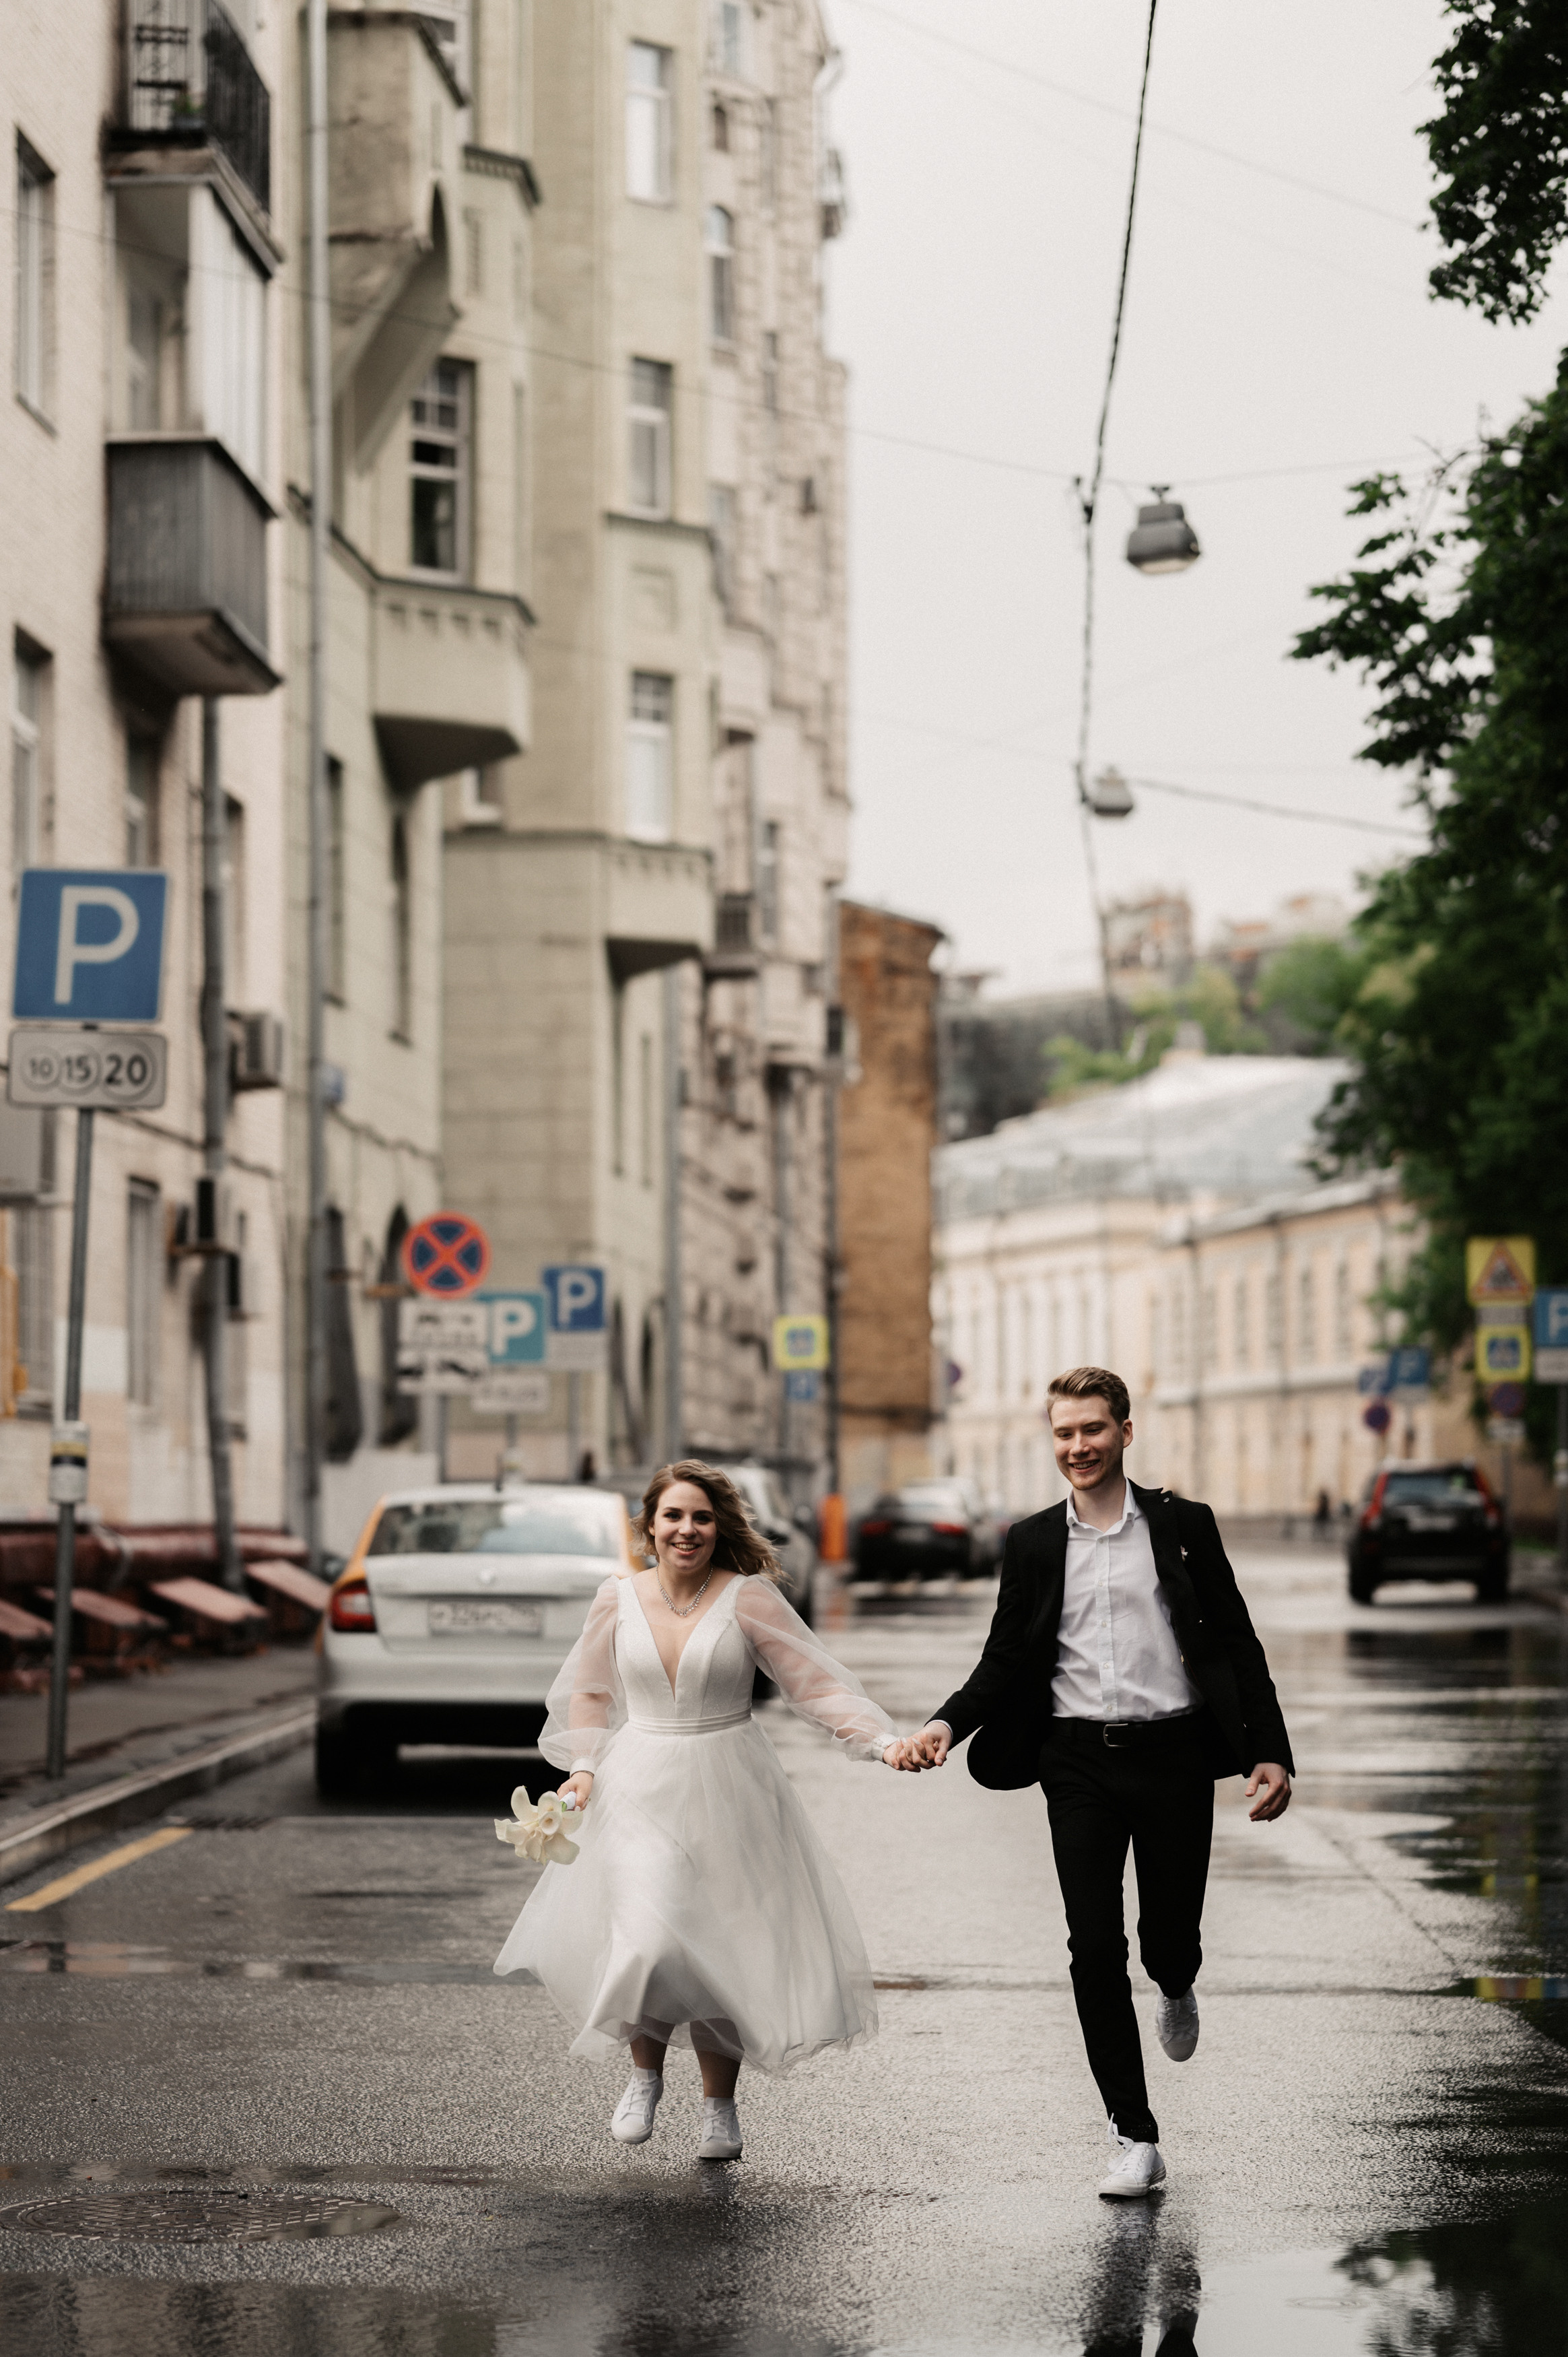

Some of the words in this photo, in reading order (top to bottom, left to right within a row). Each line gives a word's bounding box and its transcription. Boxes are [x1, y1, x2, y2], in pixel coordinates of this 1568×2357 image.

[55, 885, 139, 1005] P
[30, 1057, 53, 1077] 10
[65, 1055, 92, 1081] 15
[106, 1053, 147, 1086] 20
[557, 1270, 598, 1324] P
[491, 1300, 537, 1356] P
